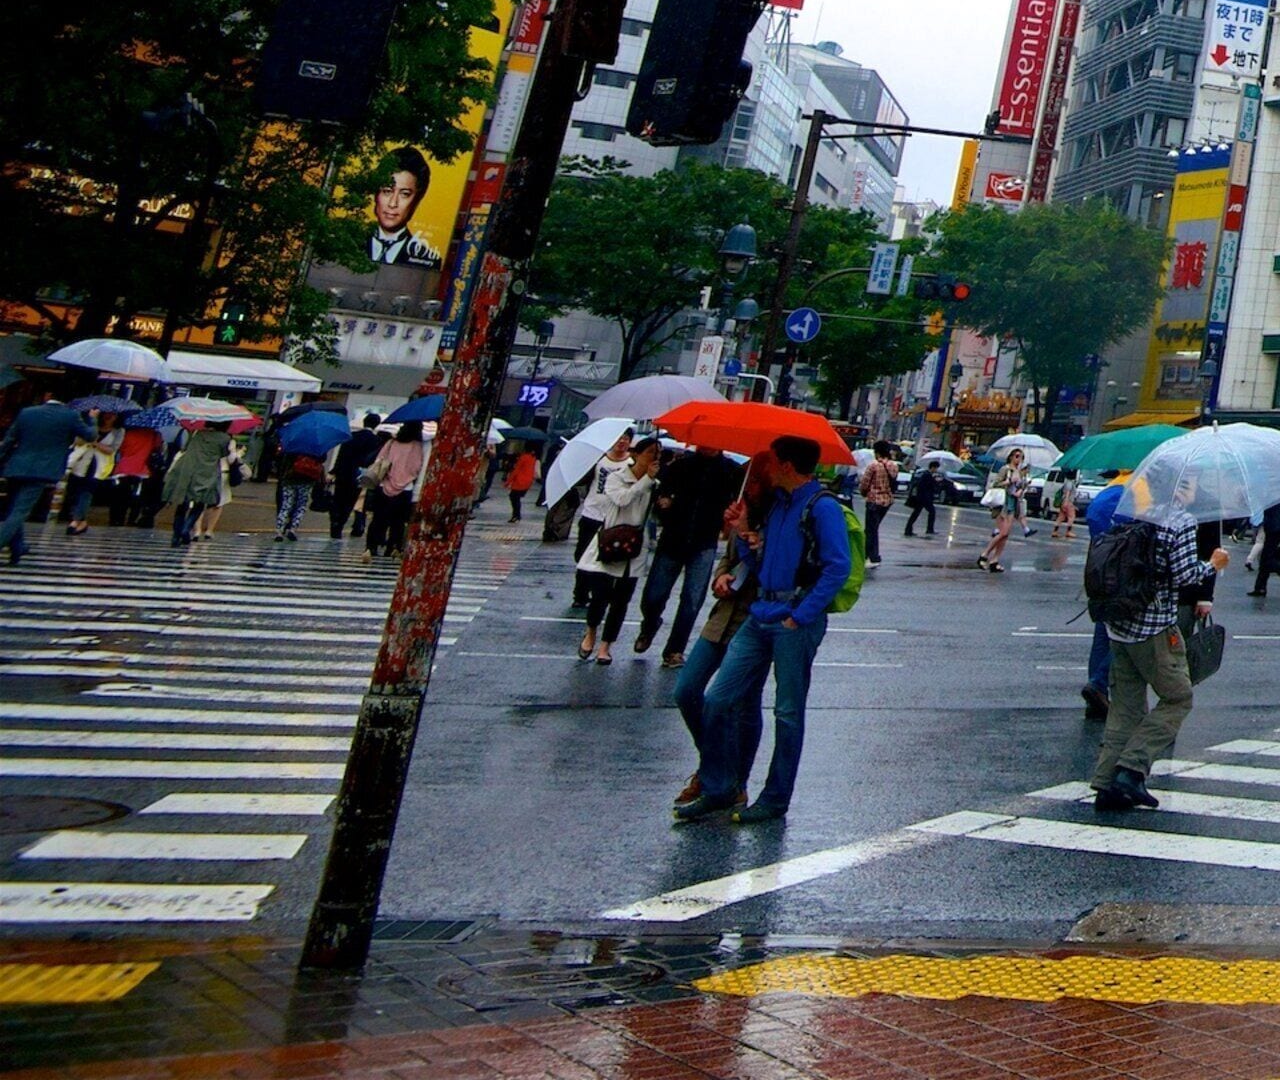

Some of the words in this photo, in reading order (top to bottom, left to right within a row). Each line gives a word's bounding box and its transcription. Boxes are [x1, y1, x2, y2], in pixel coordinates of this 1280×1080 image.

[1216, 3, 1265, 27] 夜11時
[1223, 24, 1254, 42] まで
[1232, 49, 1259, 69] 地下
